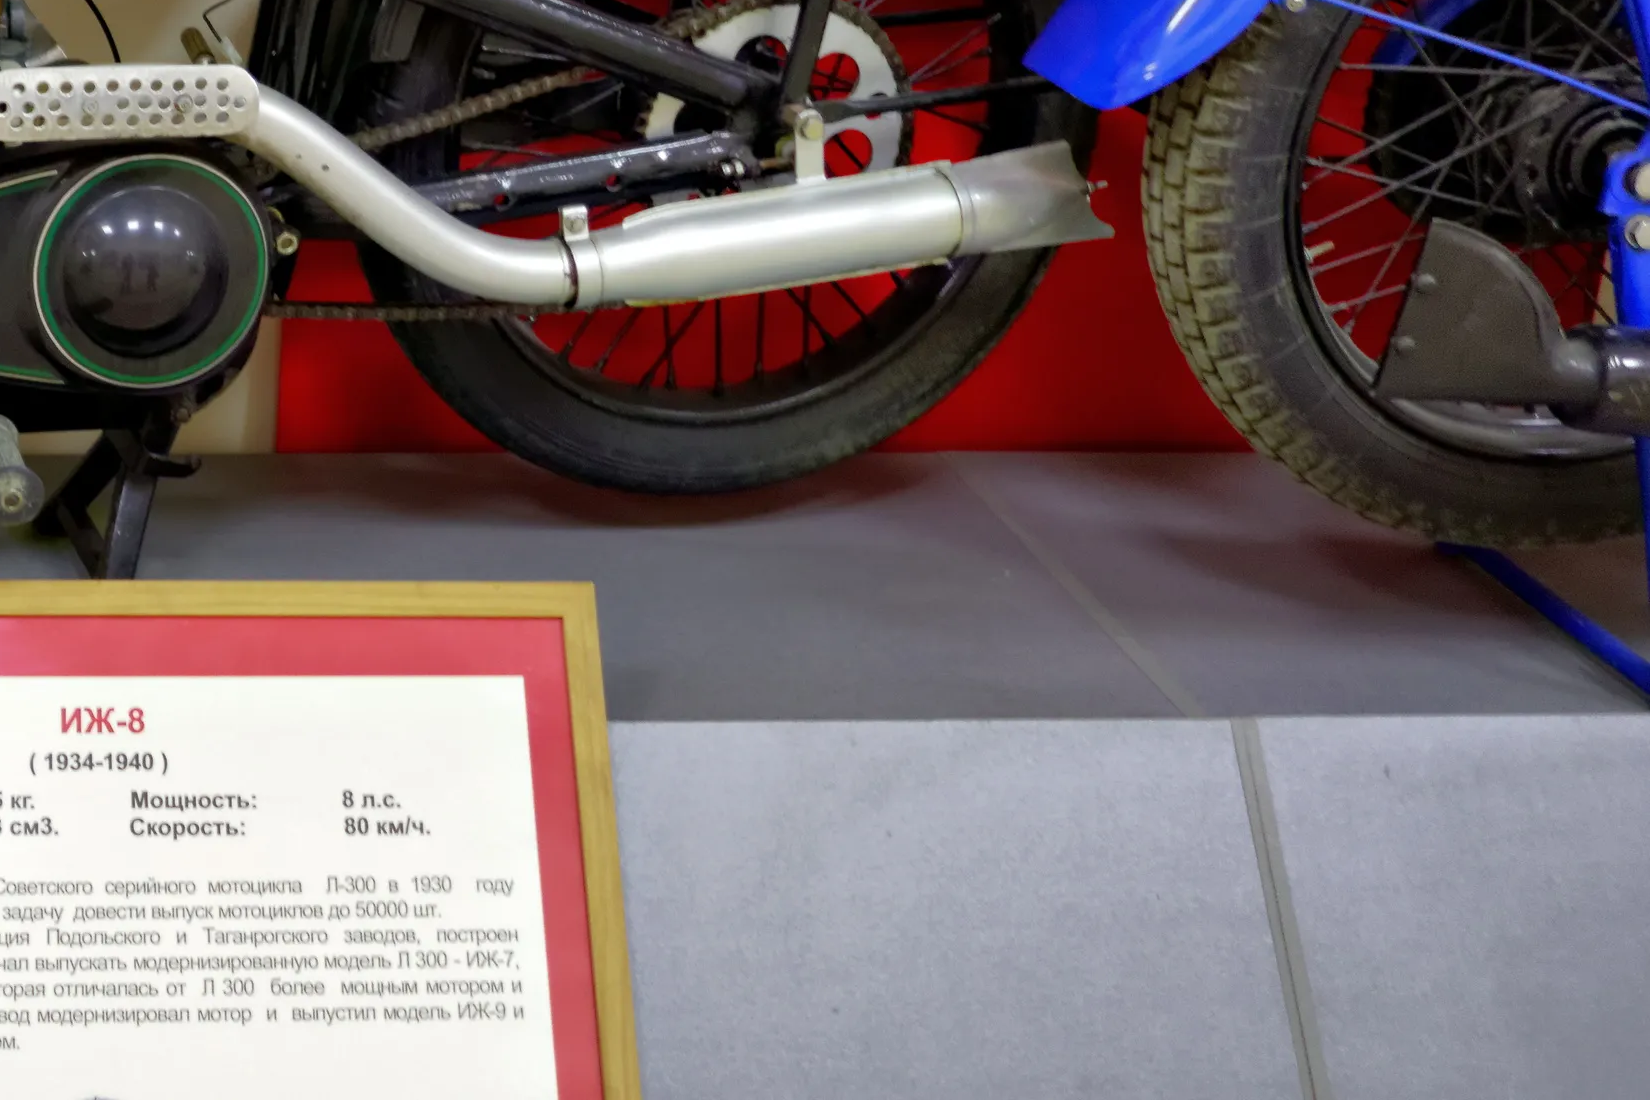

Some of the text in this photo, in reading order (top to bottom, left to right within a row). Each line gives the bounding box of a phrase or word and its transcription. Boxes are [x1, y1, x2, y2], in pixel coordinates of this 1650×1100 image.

[59, 705, 146, 736] ИЖ-8
[10, 794, 36, 811] кг.
[130, 788, 258, 813] Мощность:
[360, 793, 402, 810] л.с.
[9, 815, 59, 837] см3.
[129, 815, 431, 842] Скорость: 80 км/ч.
[104, 876, 197, 900] серийного
[207, 879, 303, 899] мотоцикла
[325, 874, 377, 895] Л-300
[411, 874, 453, 895] 1930
[475, 878, 515, 897] году
[2, 906, 65, 926] задачу
[72, 905, 147, 924] довести
[150, 905, 215, 924] выпуск
[217, 904, 324, 923] мотоциклов
[327, 903, 351, 922] до
[354, 899, 409, 920] 50000
[413, 903, 442, 919] шт.
[46, 926, 162, 950] Подольского
[202, 925, 329, 950] Таганрогского
[343, 929, 421, 948] заводов,
[436, 928, 519, 948] построен
[34, 955, 128, 977] выпускать
[133, 954, 320, 976] модернизированную
[323, 954, 393, 973] модель
[415, 949, 449, 971] 300
[465, 949, 520, 971] ИЖ-7,
[52, 982, 160, 999] отличалась
[165, 982, 187, 997] от
[222, 977, 255, 998] 300
[269, 976, 326, 997] более
[340, 980, 419, 999] мощным
[425, 979, 505, 1000] мотором
[36, 1007, 191, 1029] модернизировал
[197, 1007, 253, 1027] мотор
[291, 1006, 377, 1027] выпустил
[382, 1005, 452, 1025] модель
[457, 1000, 507, 1021] ИЖ-9
